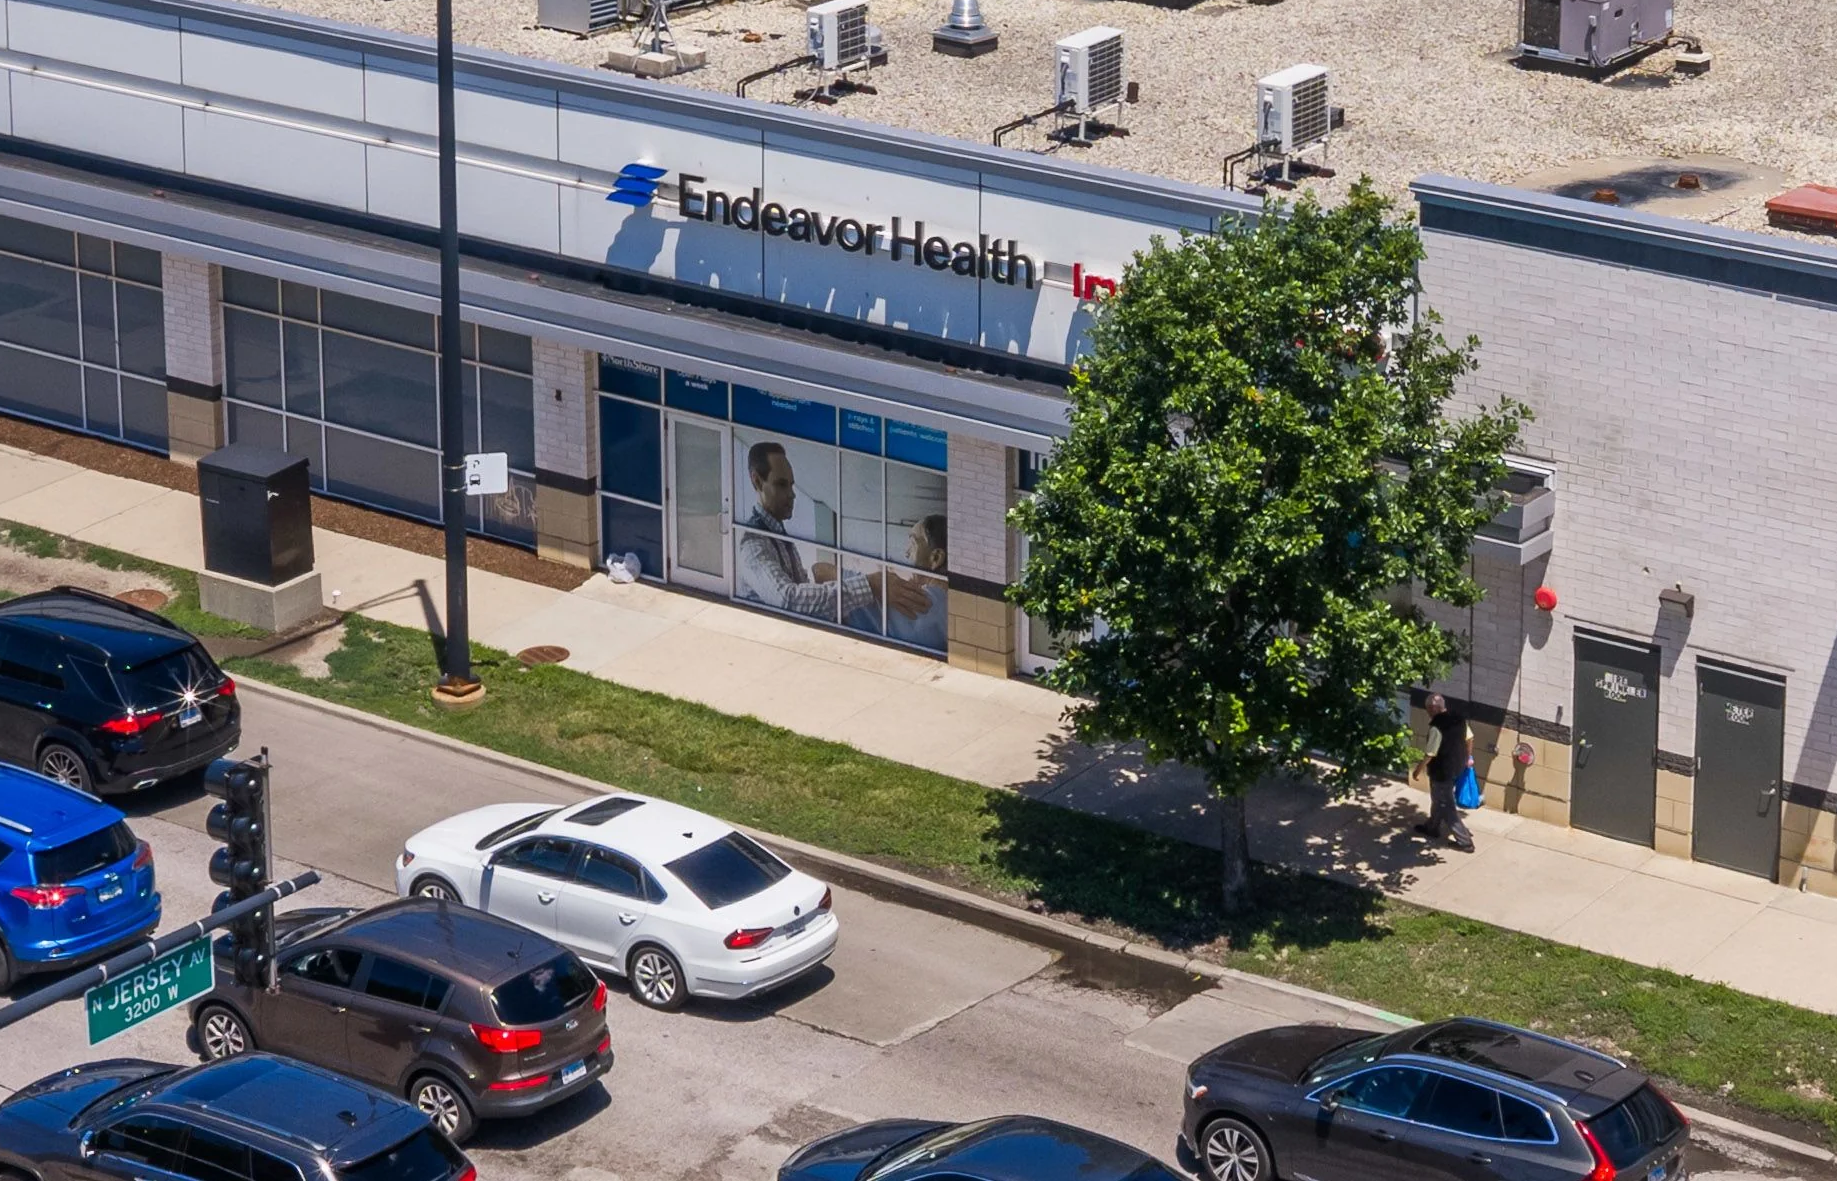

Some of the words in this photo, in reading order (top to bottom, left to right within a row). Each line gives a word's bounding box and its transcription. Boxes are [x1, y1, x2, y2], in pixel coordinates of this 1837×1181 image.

[678, 173, 884, 256] Endeavor
[891, 215, 1035, 289] Health
[92, 996, 102, 1014] N
[108, 954, 184, 1010] JERSEY
[189, 947, 206, 968] AV
[124, 993, 161, 1022] 3200
[168, 983, 179, 1000] W
